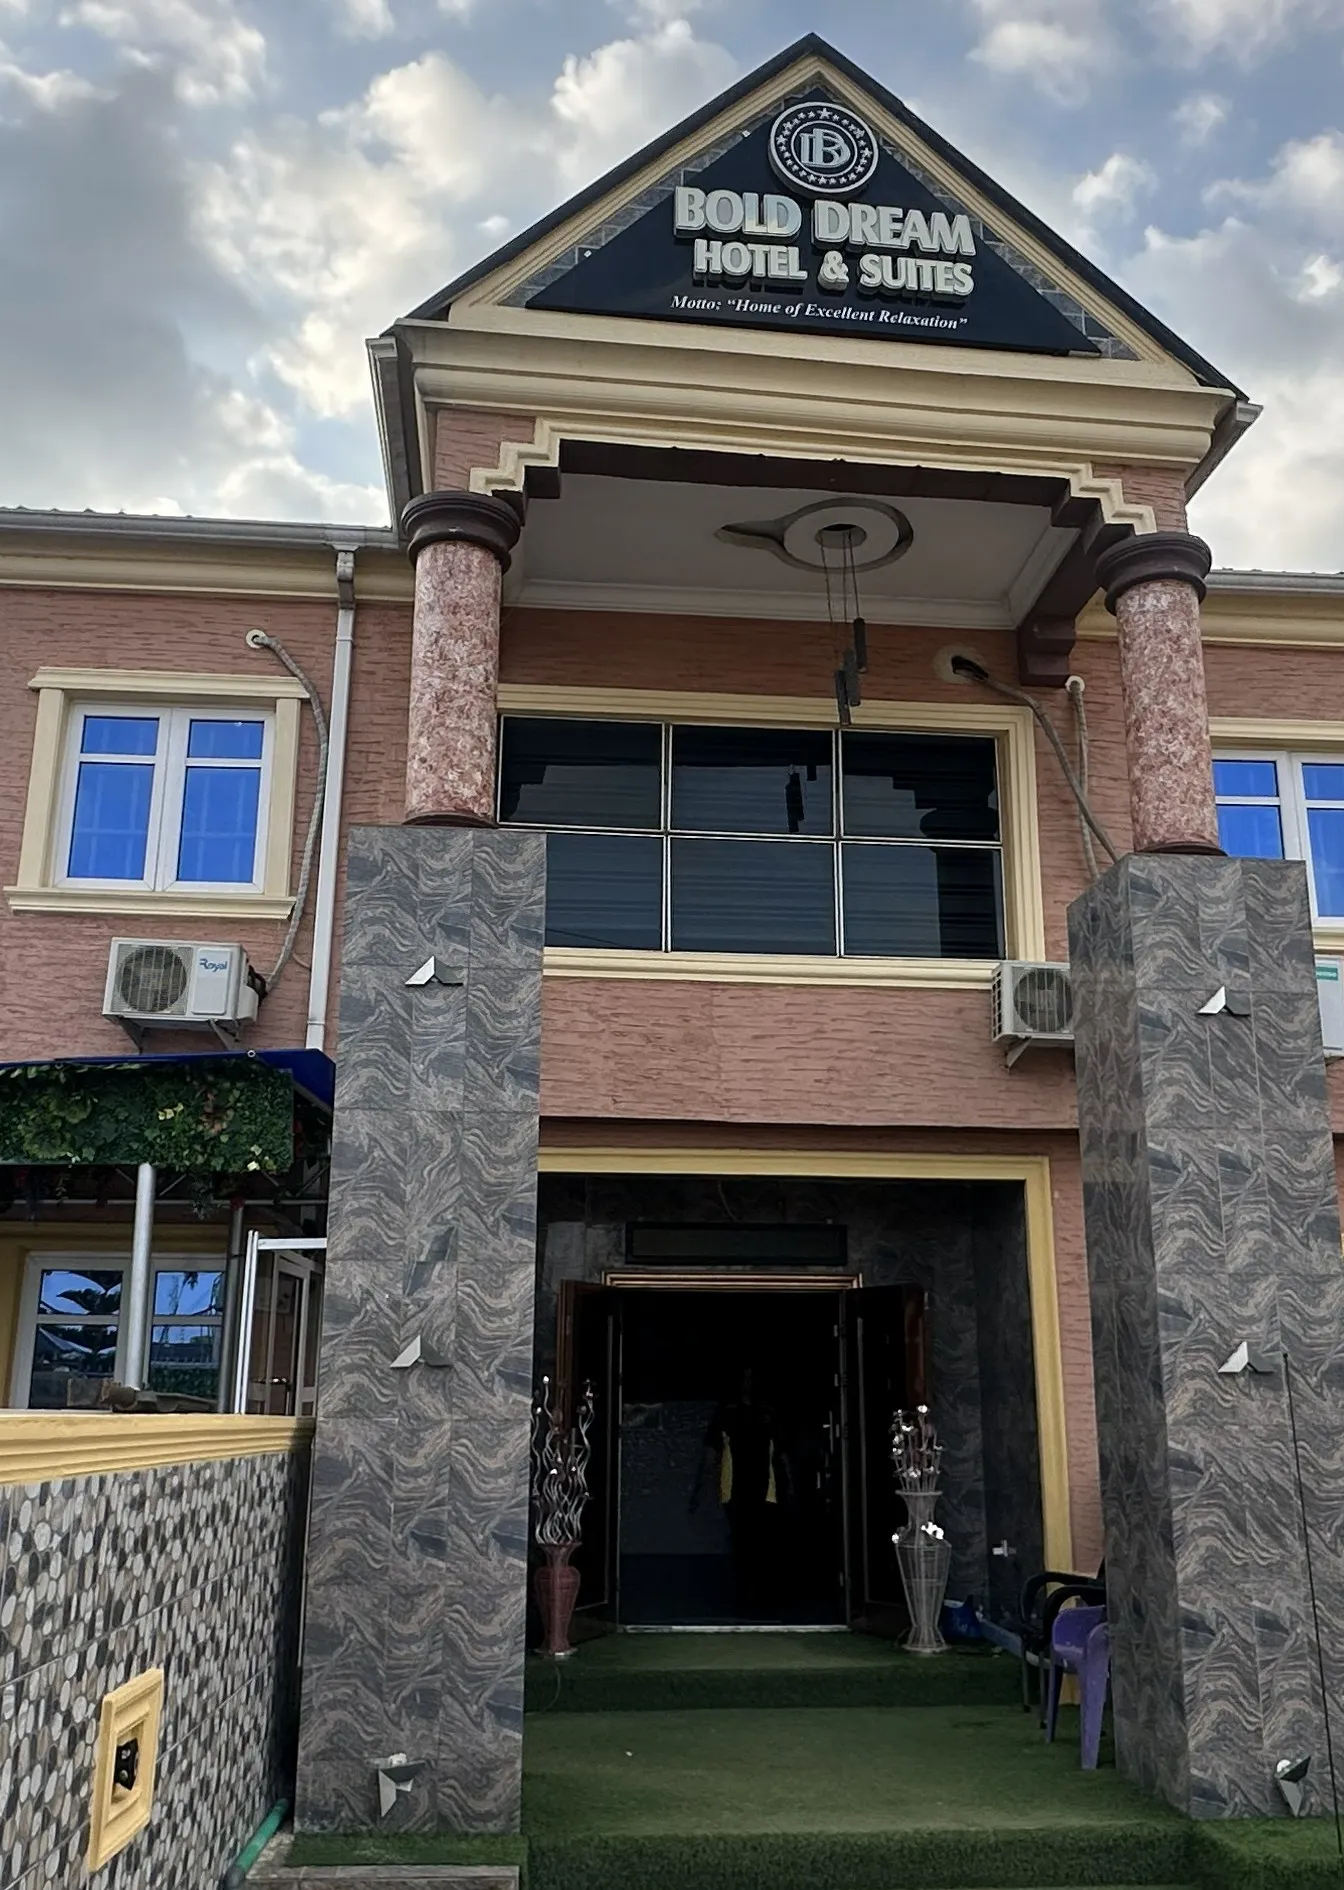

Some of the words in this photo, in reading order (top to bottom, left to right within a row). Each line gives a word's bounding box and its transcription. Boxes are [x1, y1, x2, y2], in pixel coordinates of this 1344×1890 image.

[674, 186, 802, 239] BOLD
[812, 200, 976, 256] DREAM
[693, 239, 808, 281] HOTEL
[818, 250, 849, 288] &
[859, 253, 974, 296] SUITES
[671, 295, 722, 311] Motto:
[784, 303, 804, 318] of
[805, 303, 875, 321] Excellent
[199, 958, 228, 972] Royal
